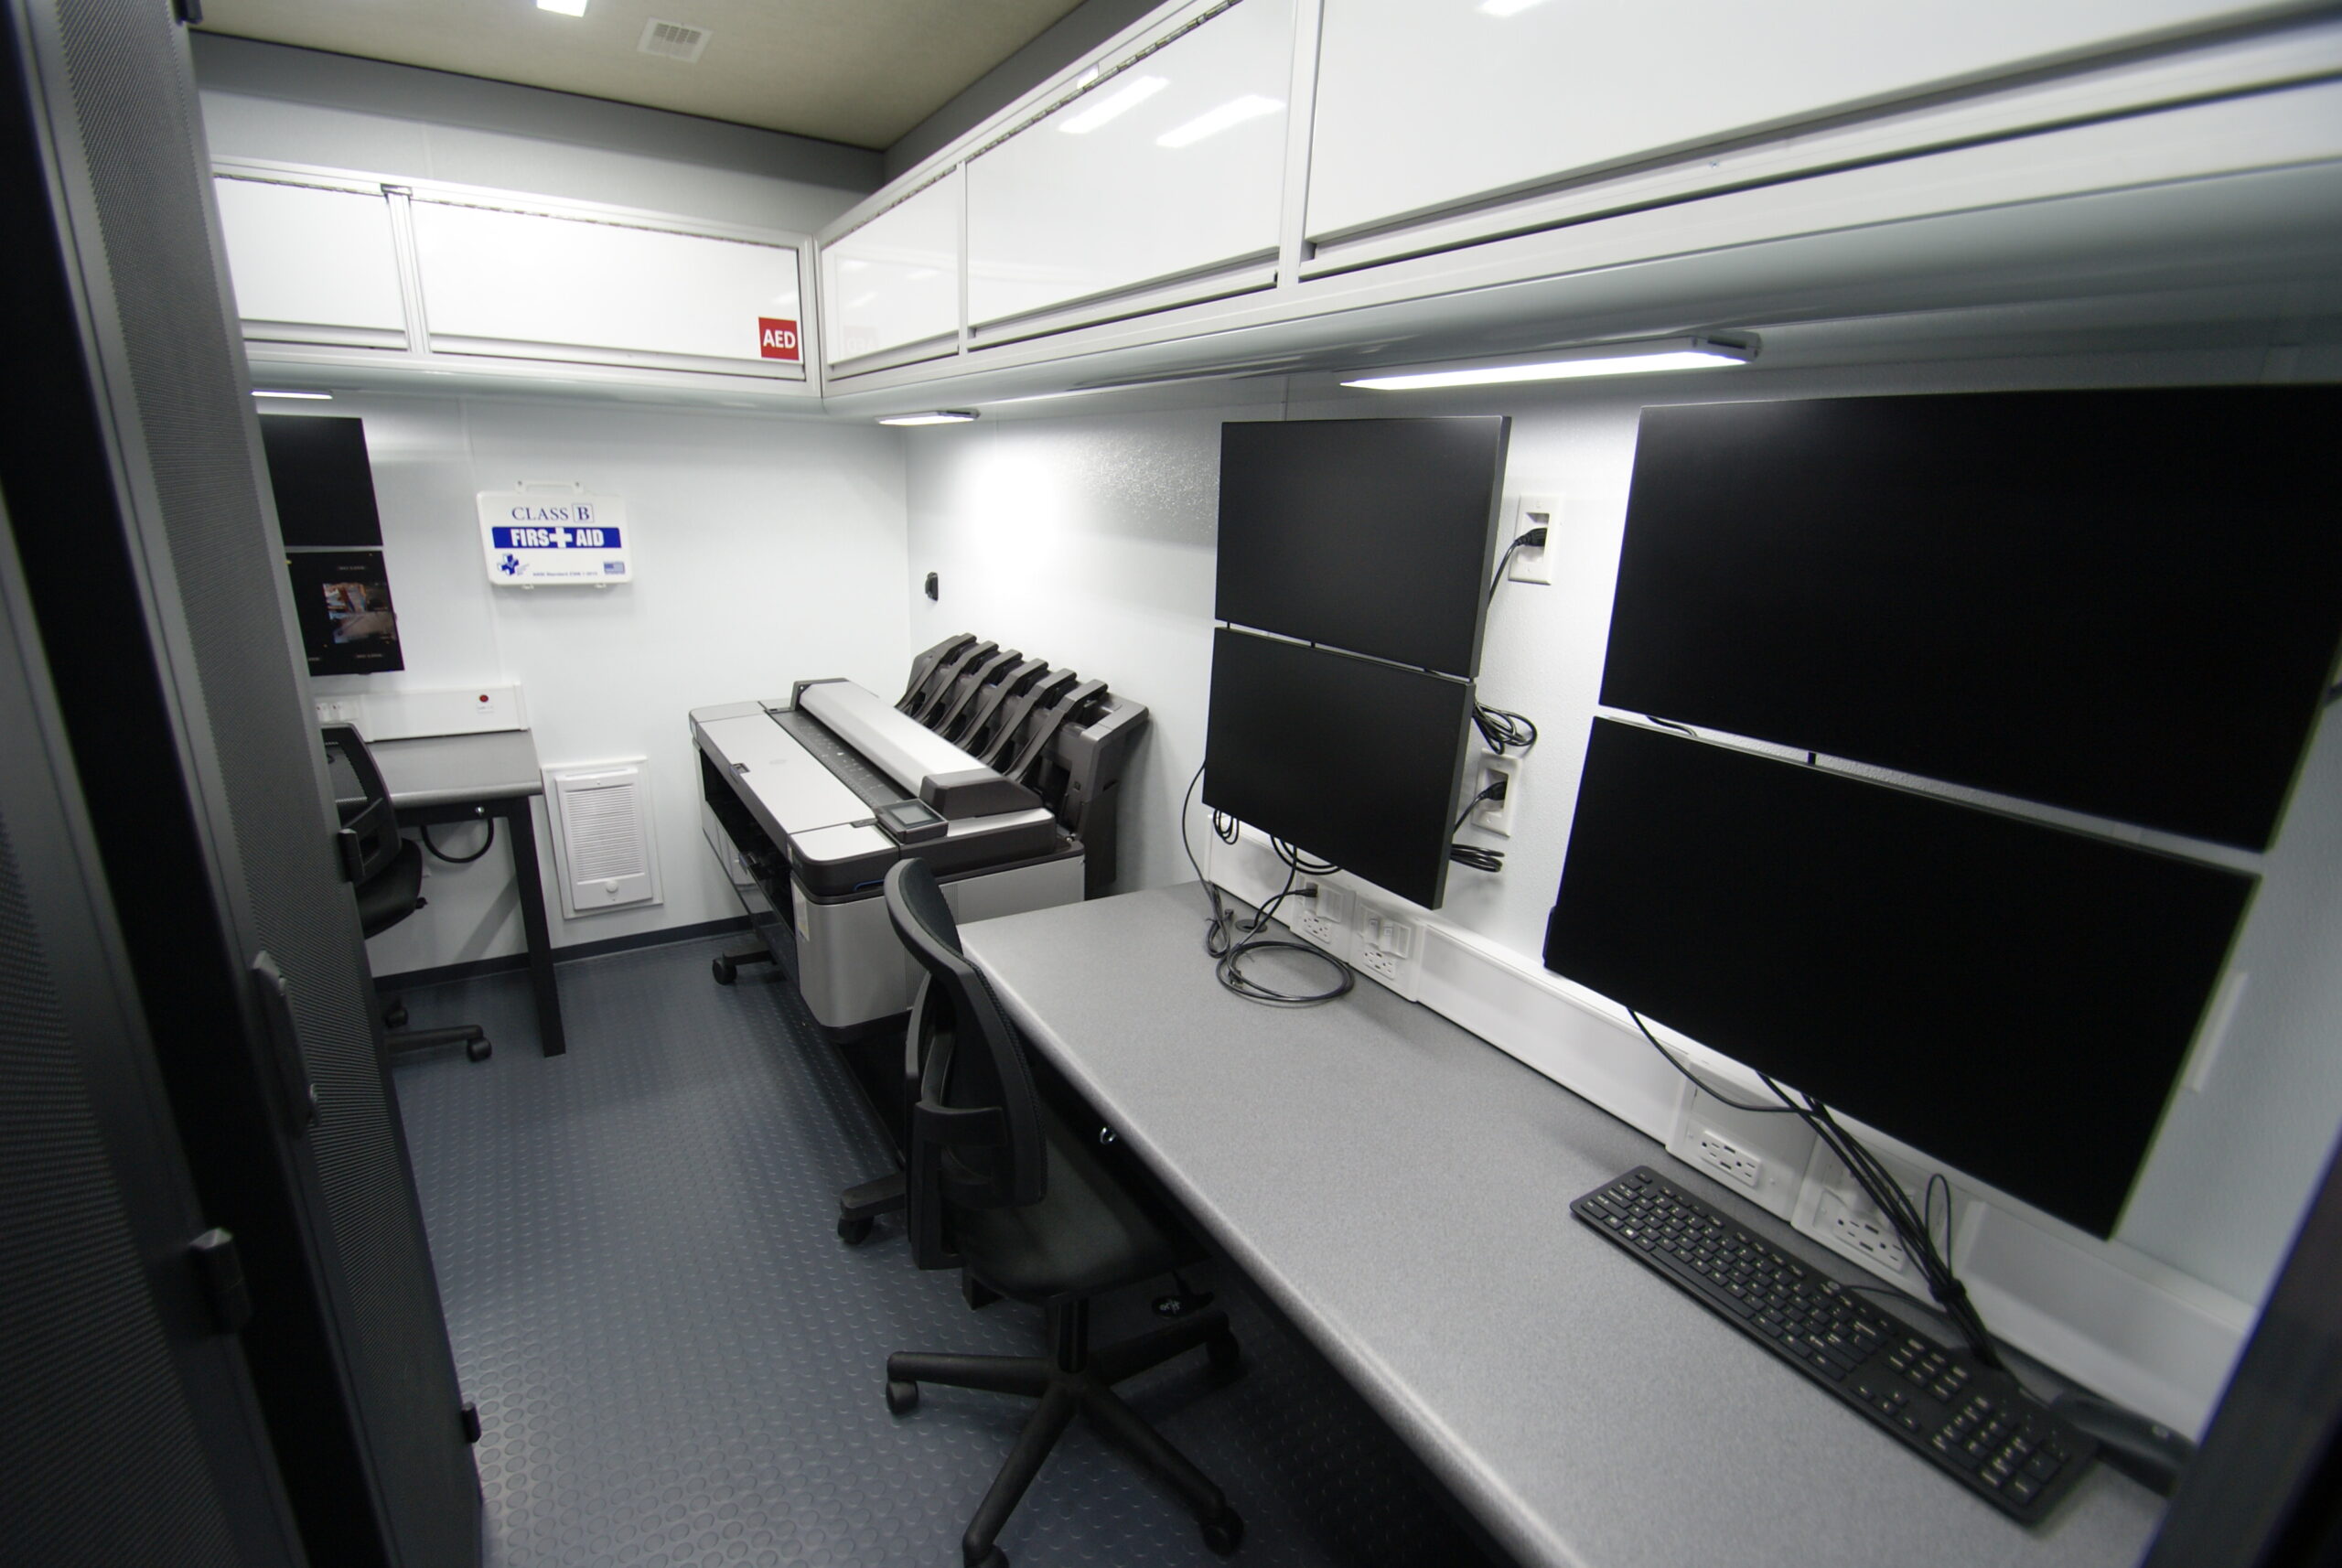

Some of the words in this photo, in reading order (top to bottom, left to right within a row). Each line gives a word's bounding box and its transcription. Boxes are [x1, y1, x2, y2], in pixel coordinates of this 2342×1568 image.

[763, 329, 796, 349] AED
[511, 506, 569, 521] CLASS
[578, 507, 590, 521] B
[575, 529, 605, 547] AID
